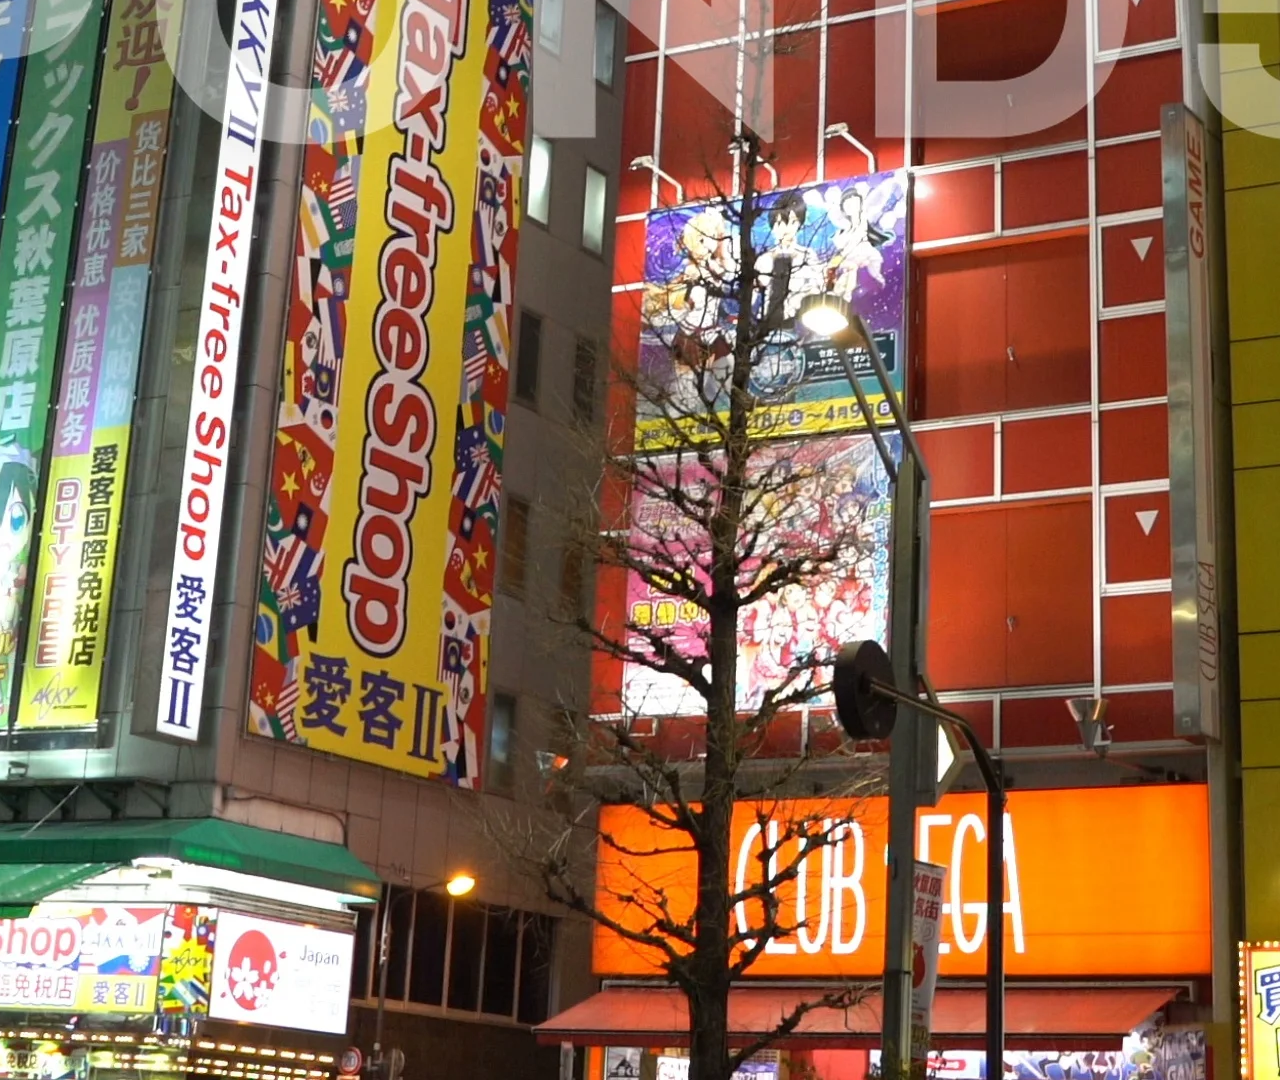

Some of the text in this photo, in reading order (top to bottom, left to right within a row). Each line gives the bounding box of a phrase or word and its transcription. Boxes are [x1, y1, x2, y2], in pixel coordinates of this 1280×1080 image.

[120, 120, 163, 258] 货比三家
[1186, 130, 1206, 261] GAME
[100, 276, 141, 420] 安心购物
[199, 164, 254, 401] Tax-free
[181, 411, 227, 563] Shop
[34, 477, 83, 669] DUTY FREE
[1196, 560, 1216, 618] SEGA
[734, 817, 866, 955] CLUB
[299, 945, 340, 966] Japan
